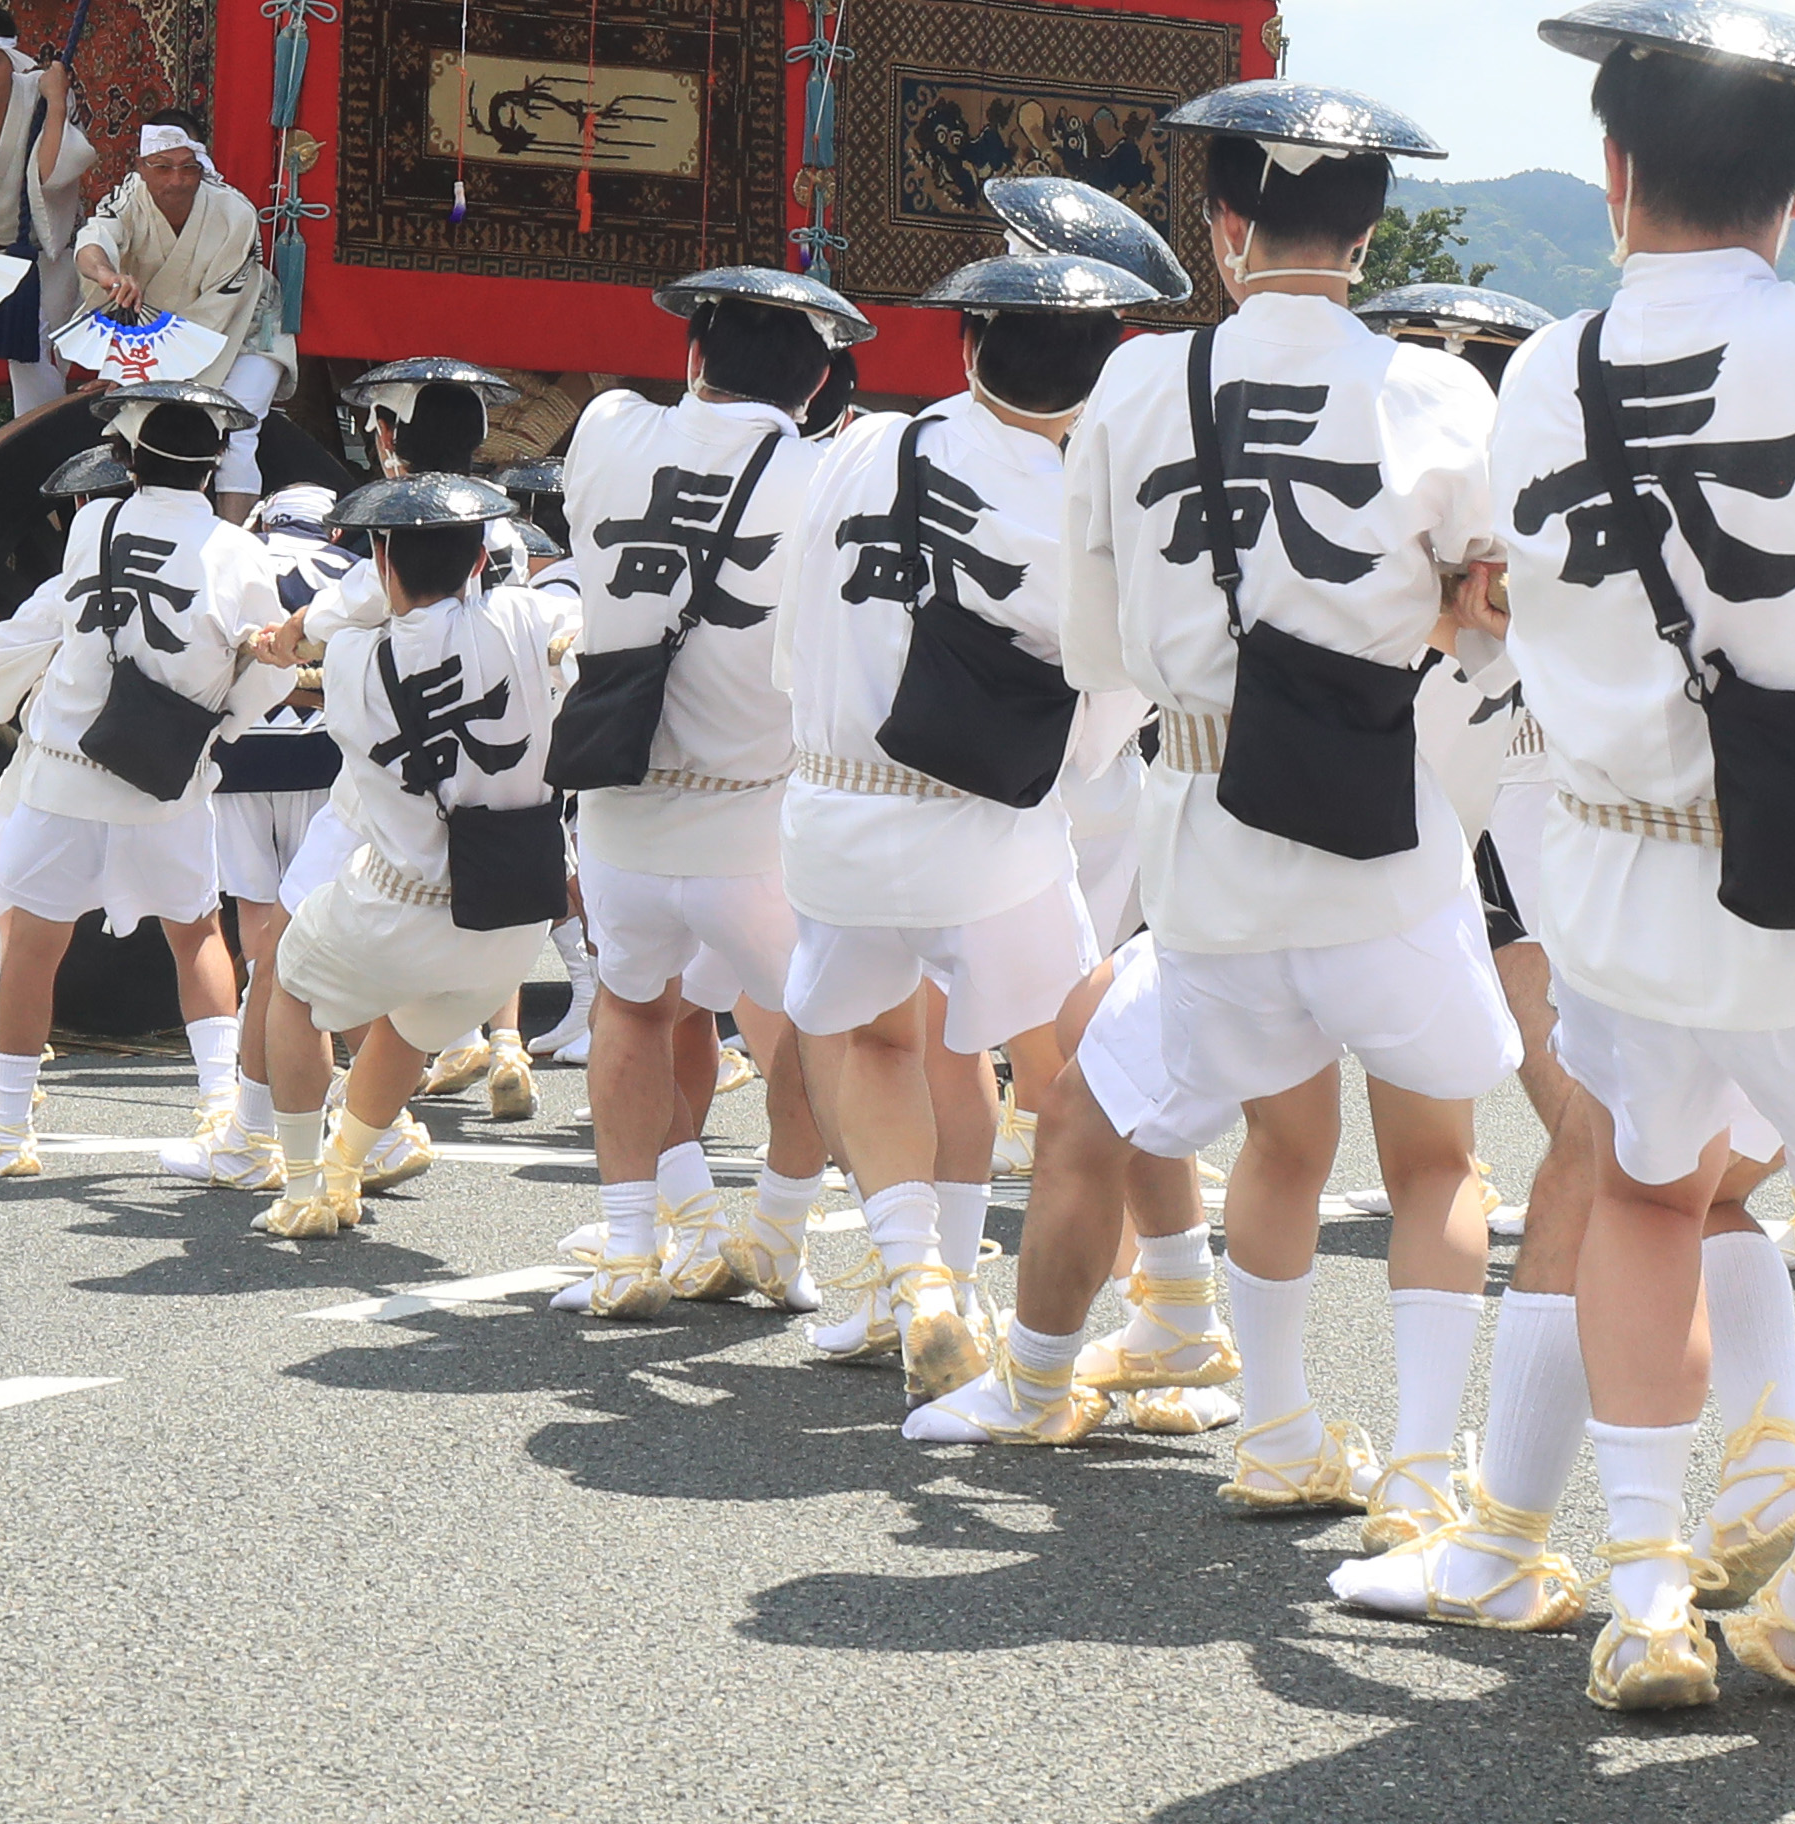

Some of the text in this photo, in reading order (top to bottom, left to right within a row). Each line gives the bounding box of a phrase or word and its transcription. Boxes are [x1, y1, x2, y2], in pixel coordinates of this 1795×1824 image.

[106, 338, 159, 382] 長
[593, 464, 783, 630] 長
[836, 455, 1028, 643] 長
[1136, 380, 1384, 584] 長
[65, 532, 199, 655] 長
[369, 655, 531, 795] 長
